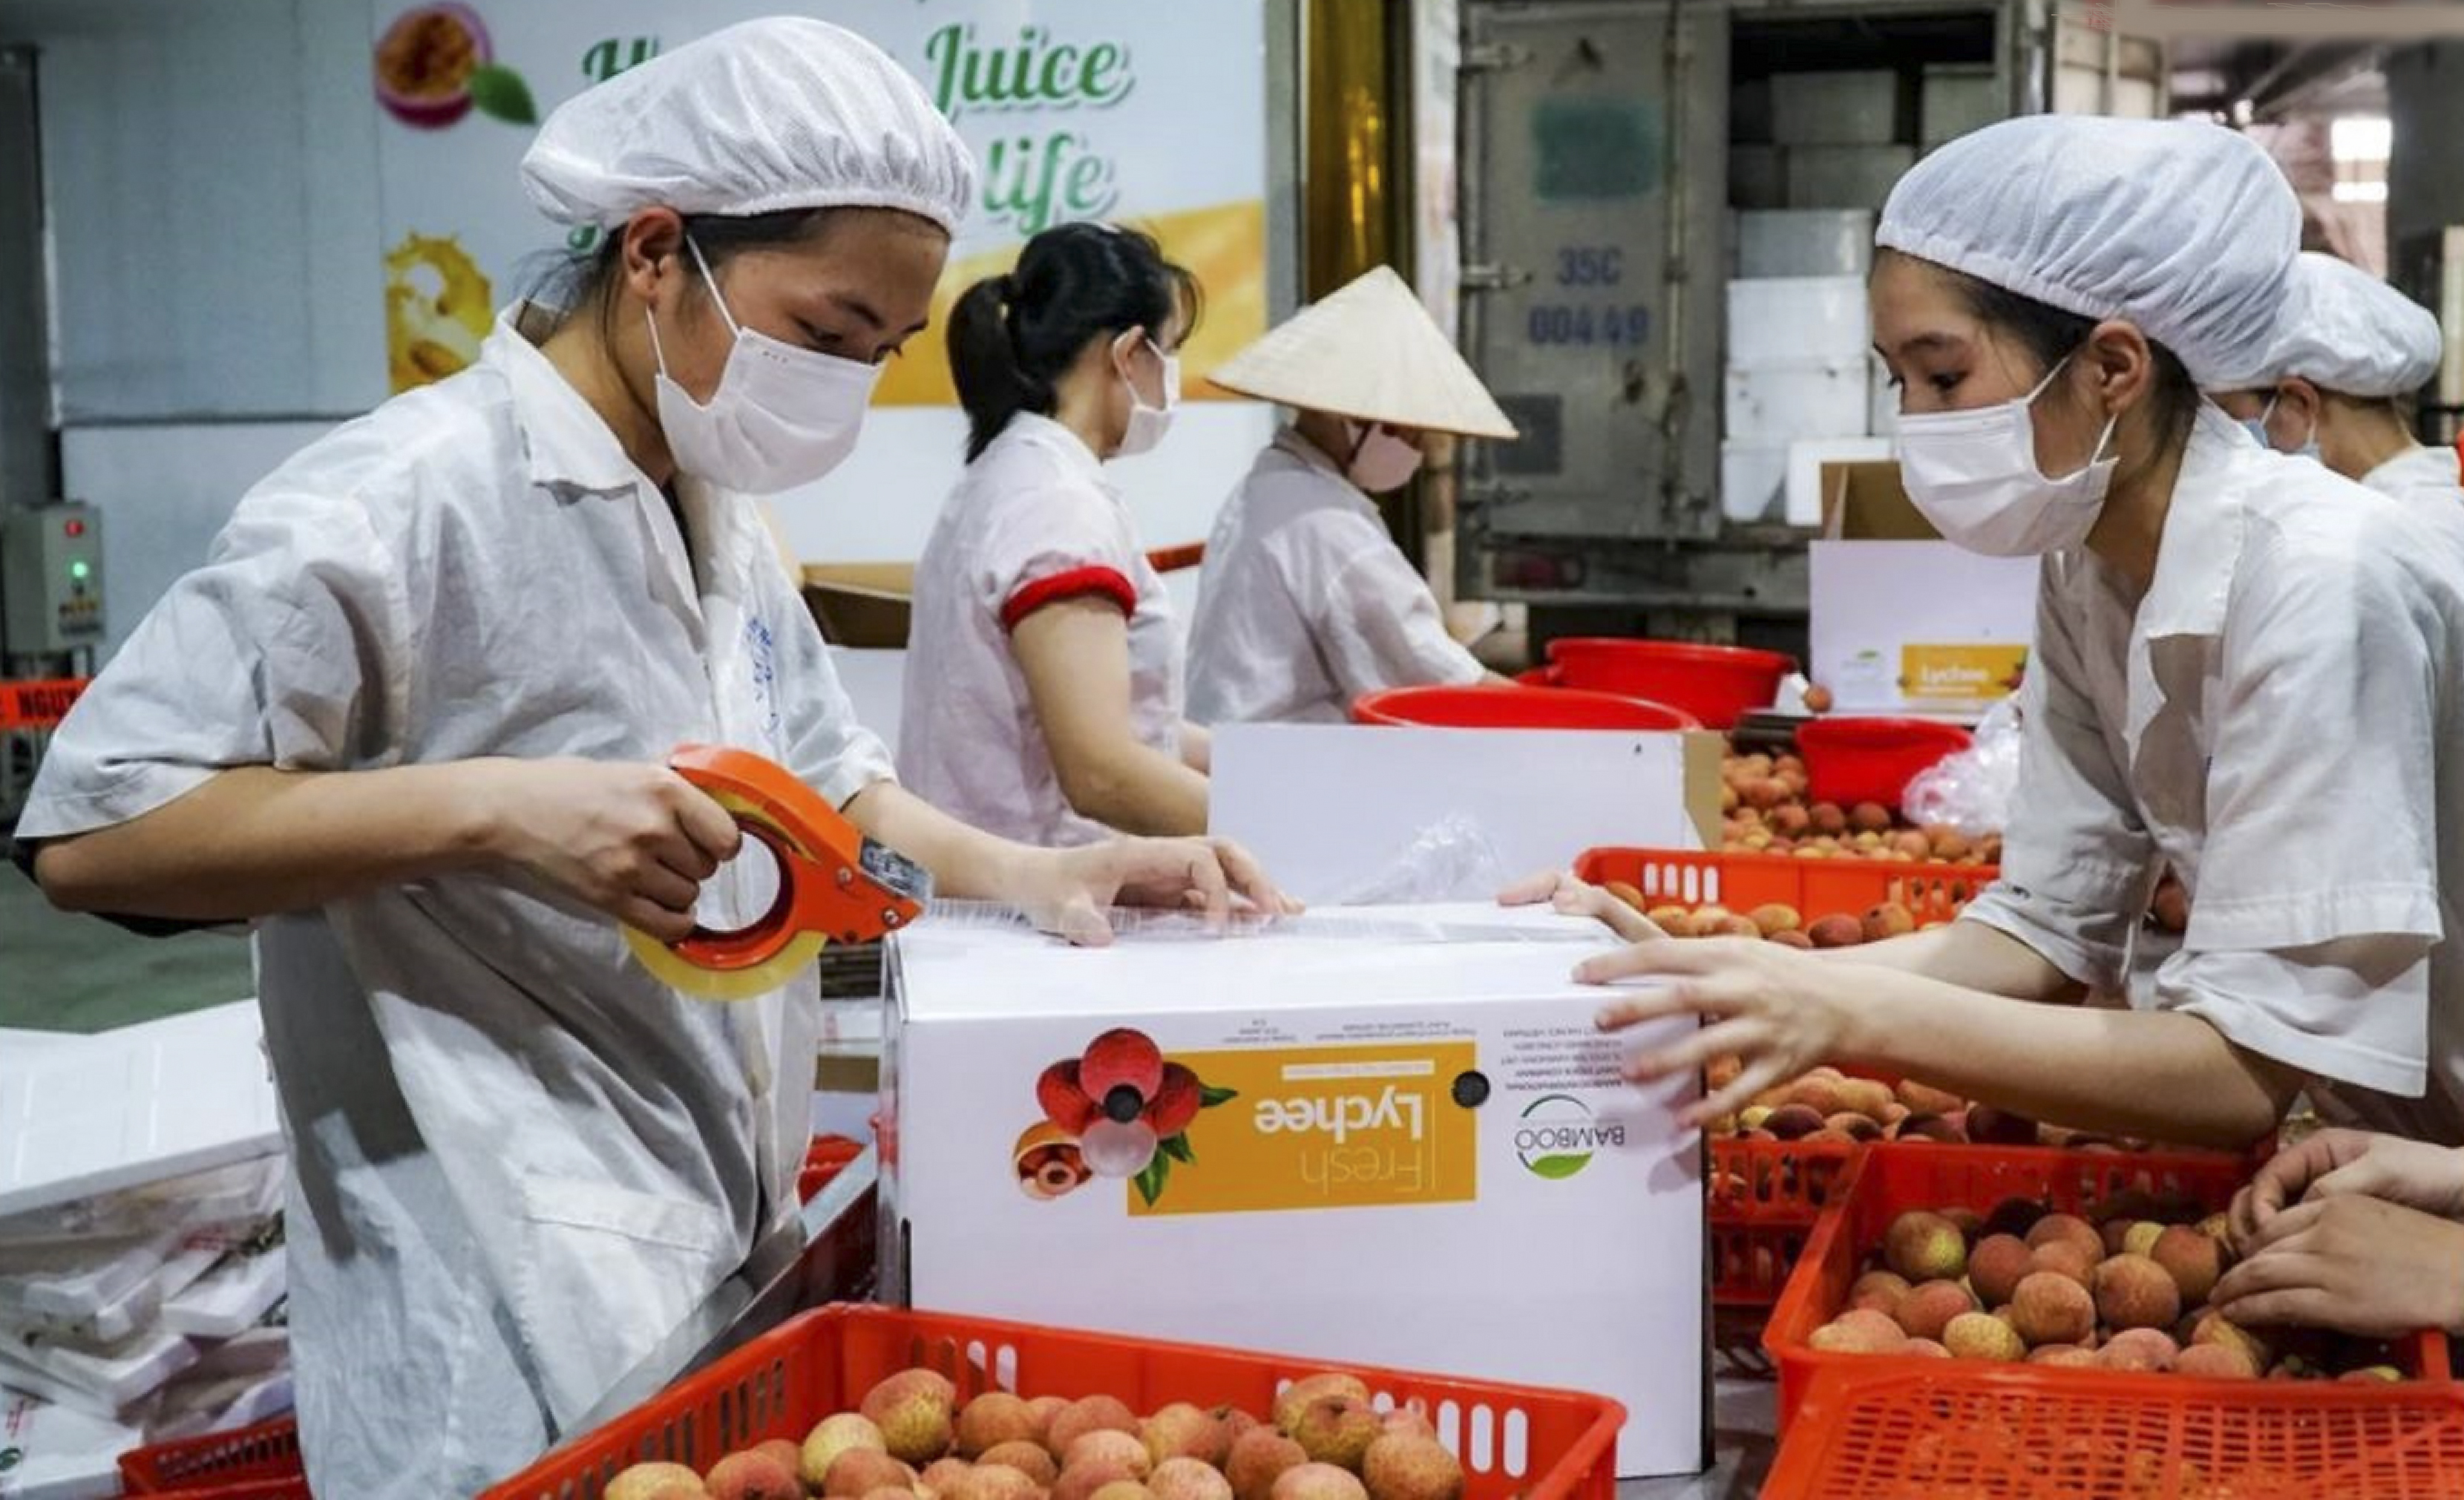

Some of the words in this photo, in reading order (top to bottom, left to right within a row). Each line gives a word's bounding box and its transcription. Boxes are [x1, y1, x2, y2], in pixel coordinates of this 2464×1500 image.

[925, 26, 1121, 114] Juice
[983, 132, 1106, 232] life
[1556, 246, 1622, 286] 35C
[1254, 1084, 1423, 1144] Lychee
[1514, 1125, 1625, 1150] BAMBOO
[1301, 1147, 1423, 1196] Fresh
